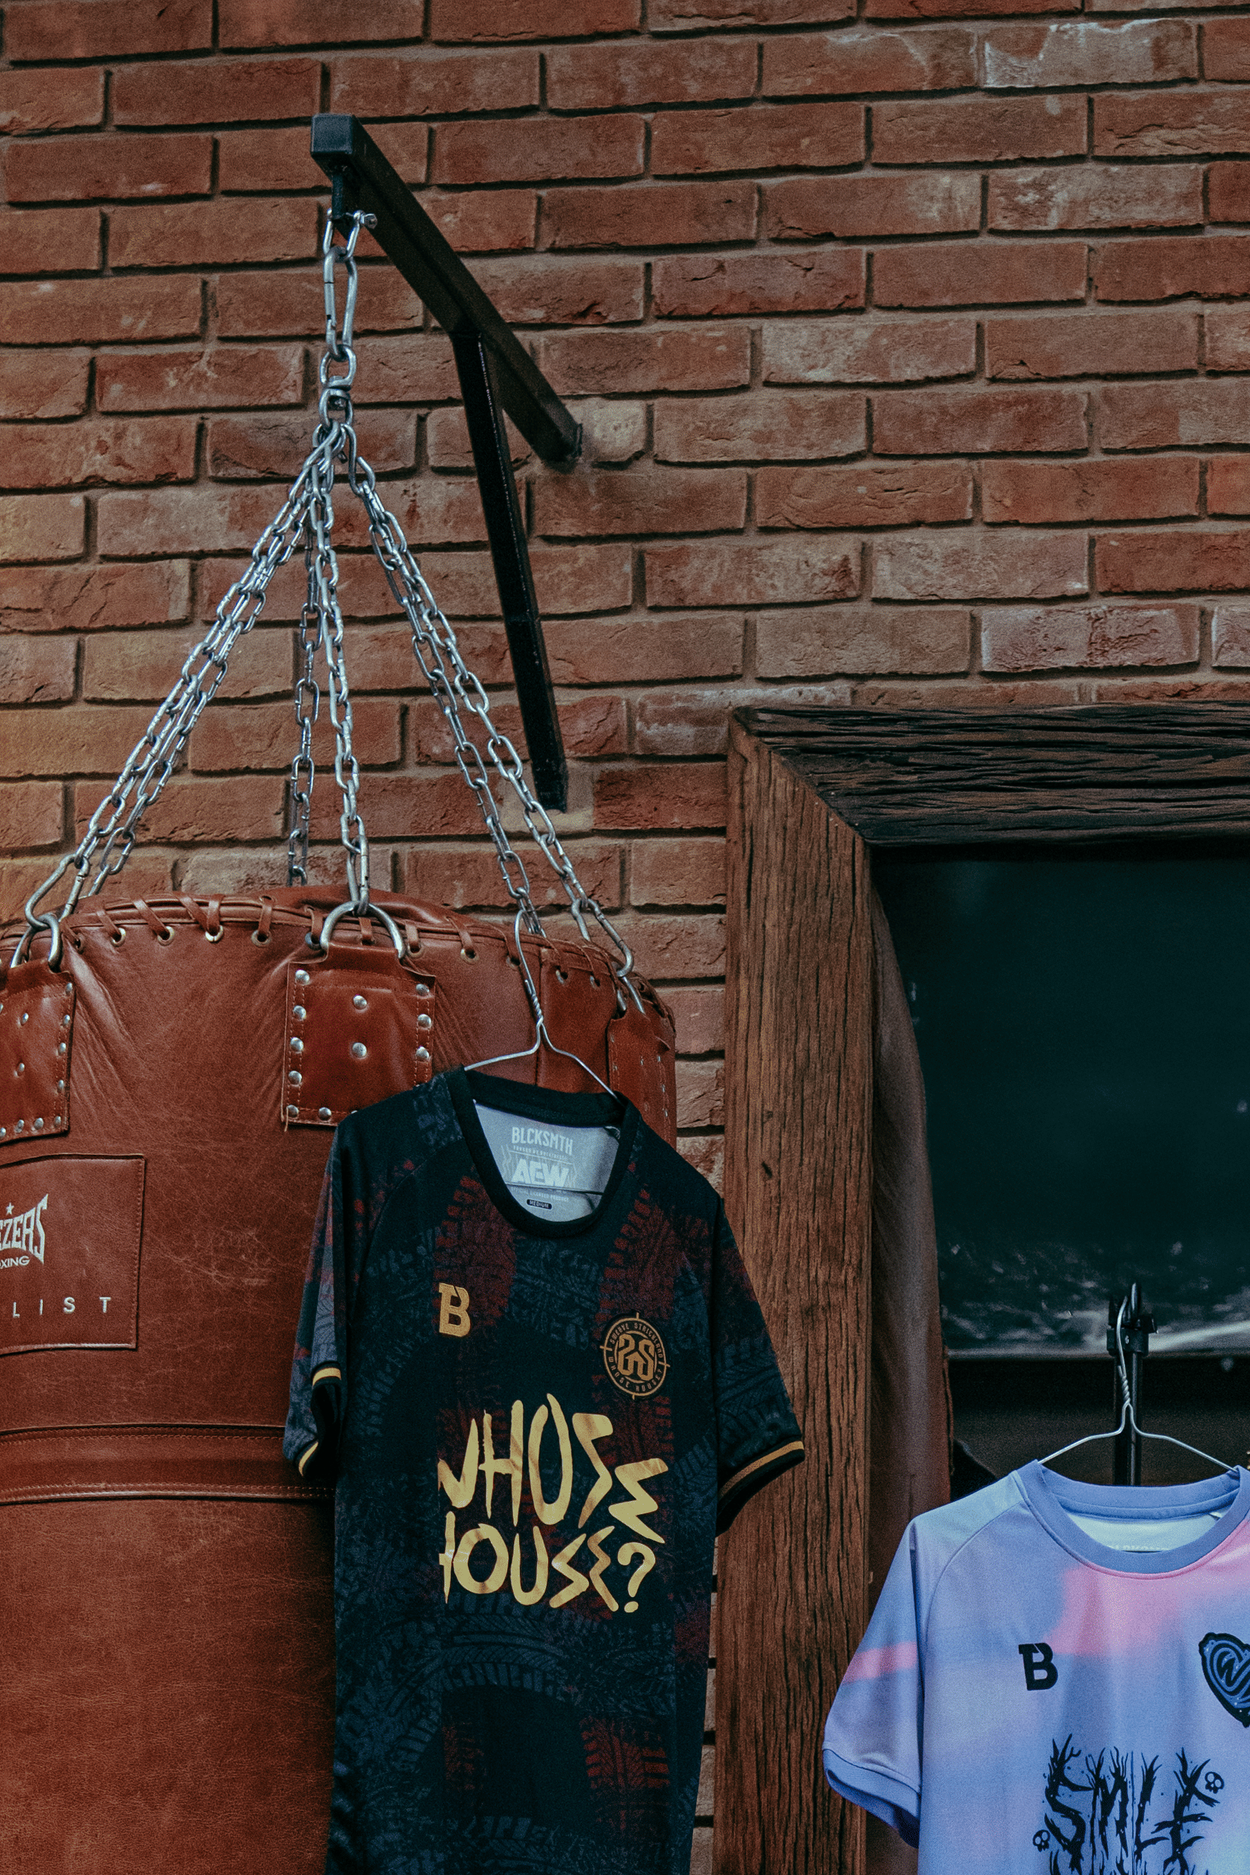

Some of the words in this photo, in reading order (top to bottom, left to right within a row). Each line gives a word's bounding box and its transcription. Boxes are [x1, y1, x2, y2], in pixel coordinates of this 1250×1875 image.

[510, 1126, 574, 1156] BLCKSMTH
[510, 1158, 570, 1188] AEW
[0, 1194, 48, 1264] ZERS
[0, 1255, 30, 1270] XING
[438, 1282, 471, 1338] B
[1018, 1642, 1059, 1691] B
